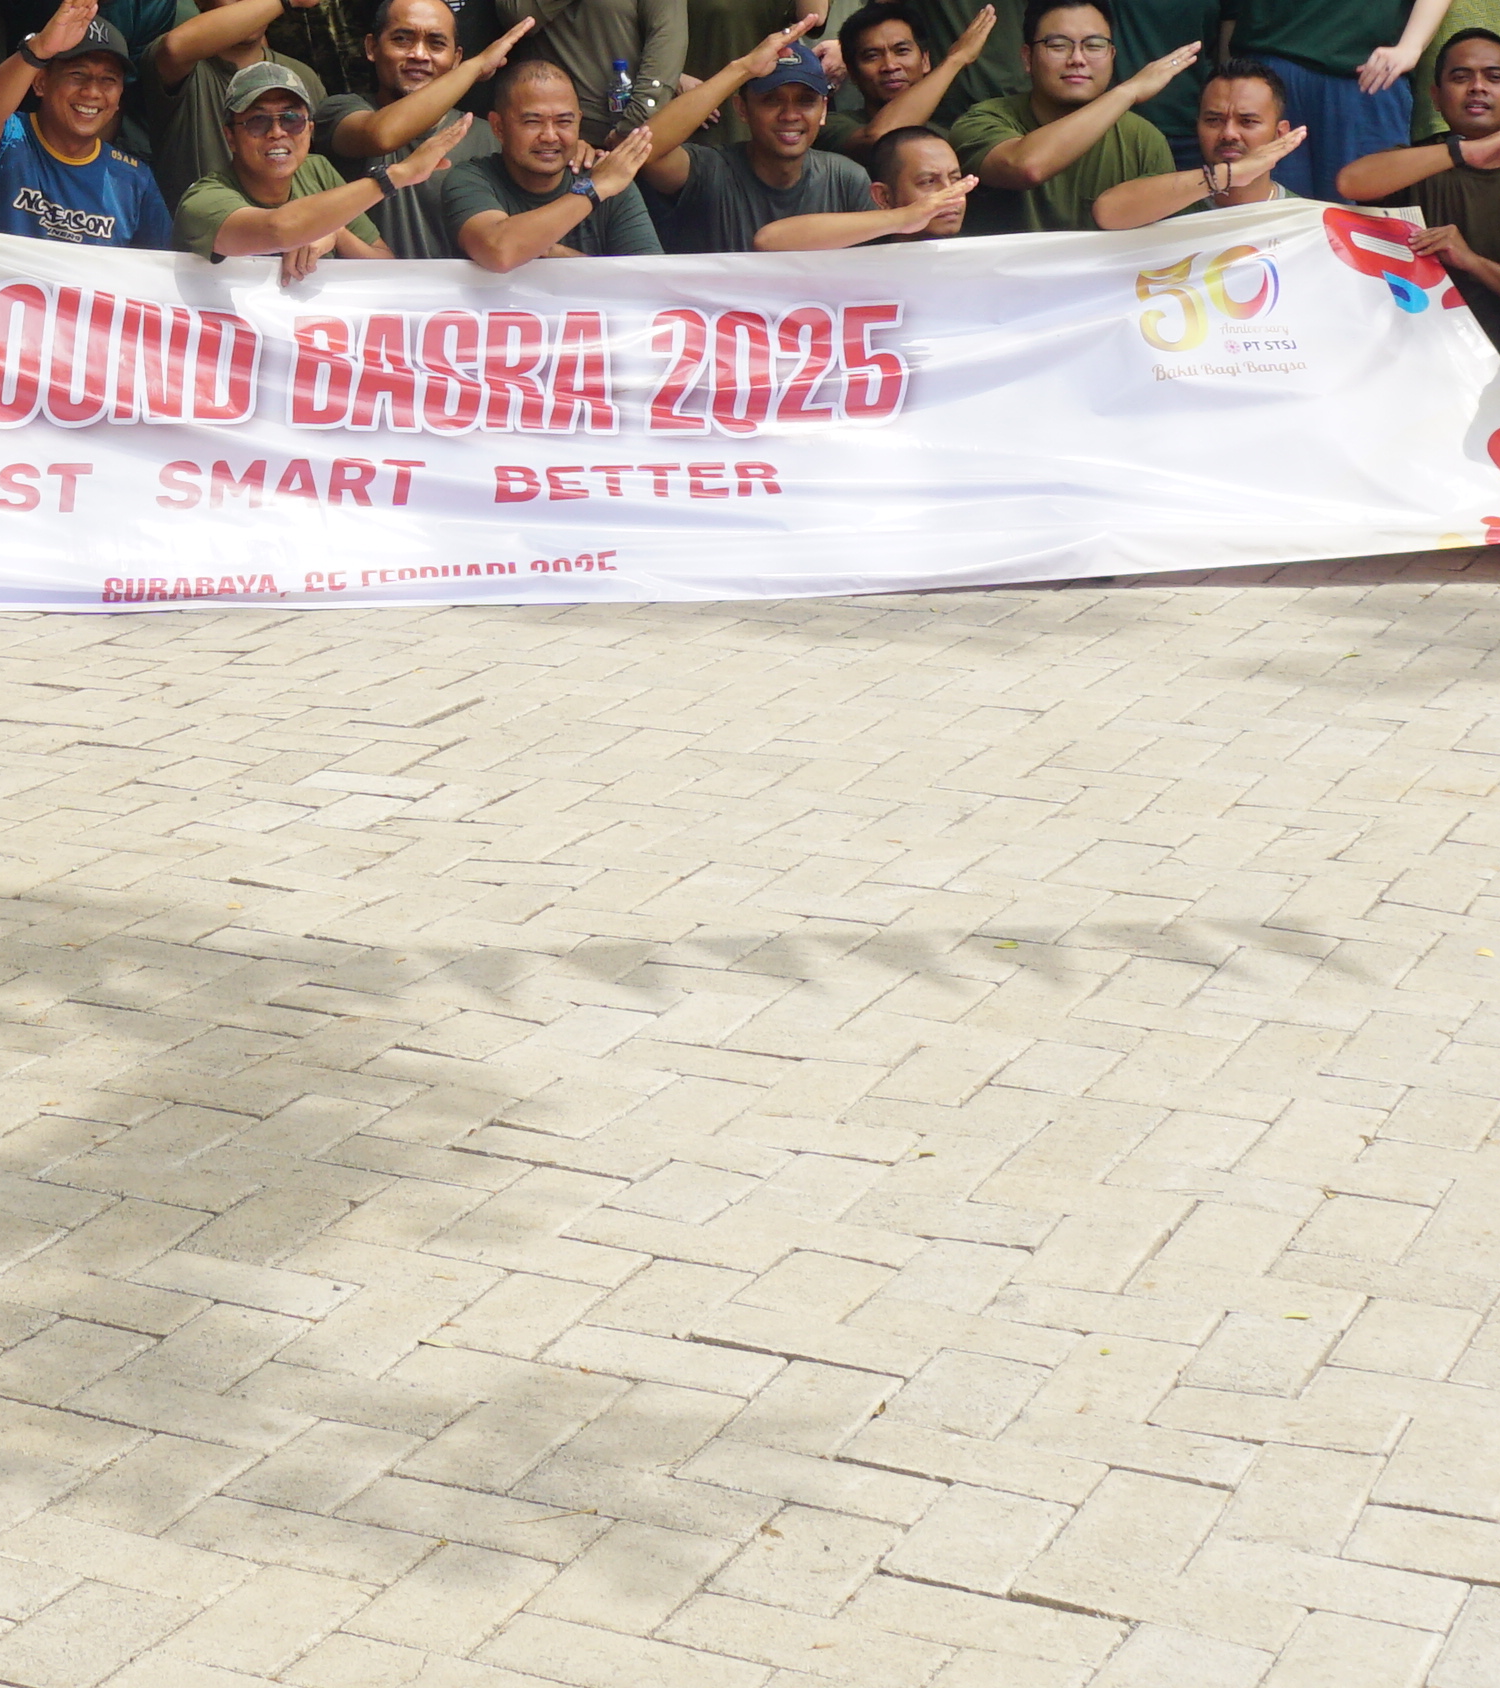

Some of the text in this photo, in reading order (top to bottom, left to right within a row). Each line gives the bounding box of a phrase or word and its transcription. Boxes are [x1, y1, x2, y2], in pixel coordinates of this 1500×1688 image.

[89, 20, 109, 43] NY
[1219, 321, 1290, 337] Anniversary
[1243, 339, 1298, 352] PT STSJ
[289, 308, 619, 435] BASRA
[647, 302, 908, 436] 2025
[1151, 360, 1308, 382] Bakti Bagi Bangsa
[155, 457, 426, 510] SMART
[493, 460, 783, 504] BETTER
